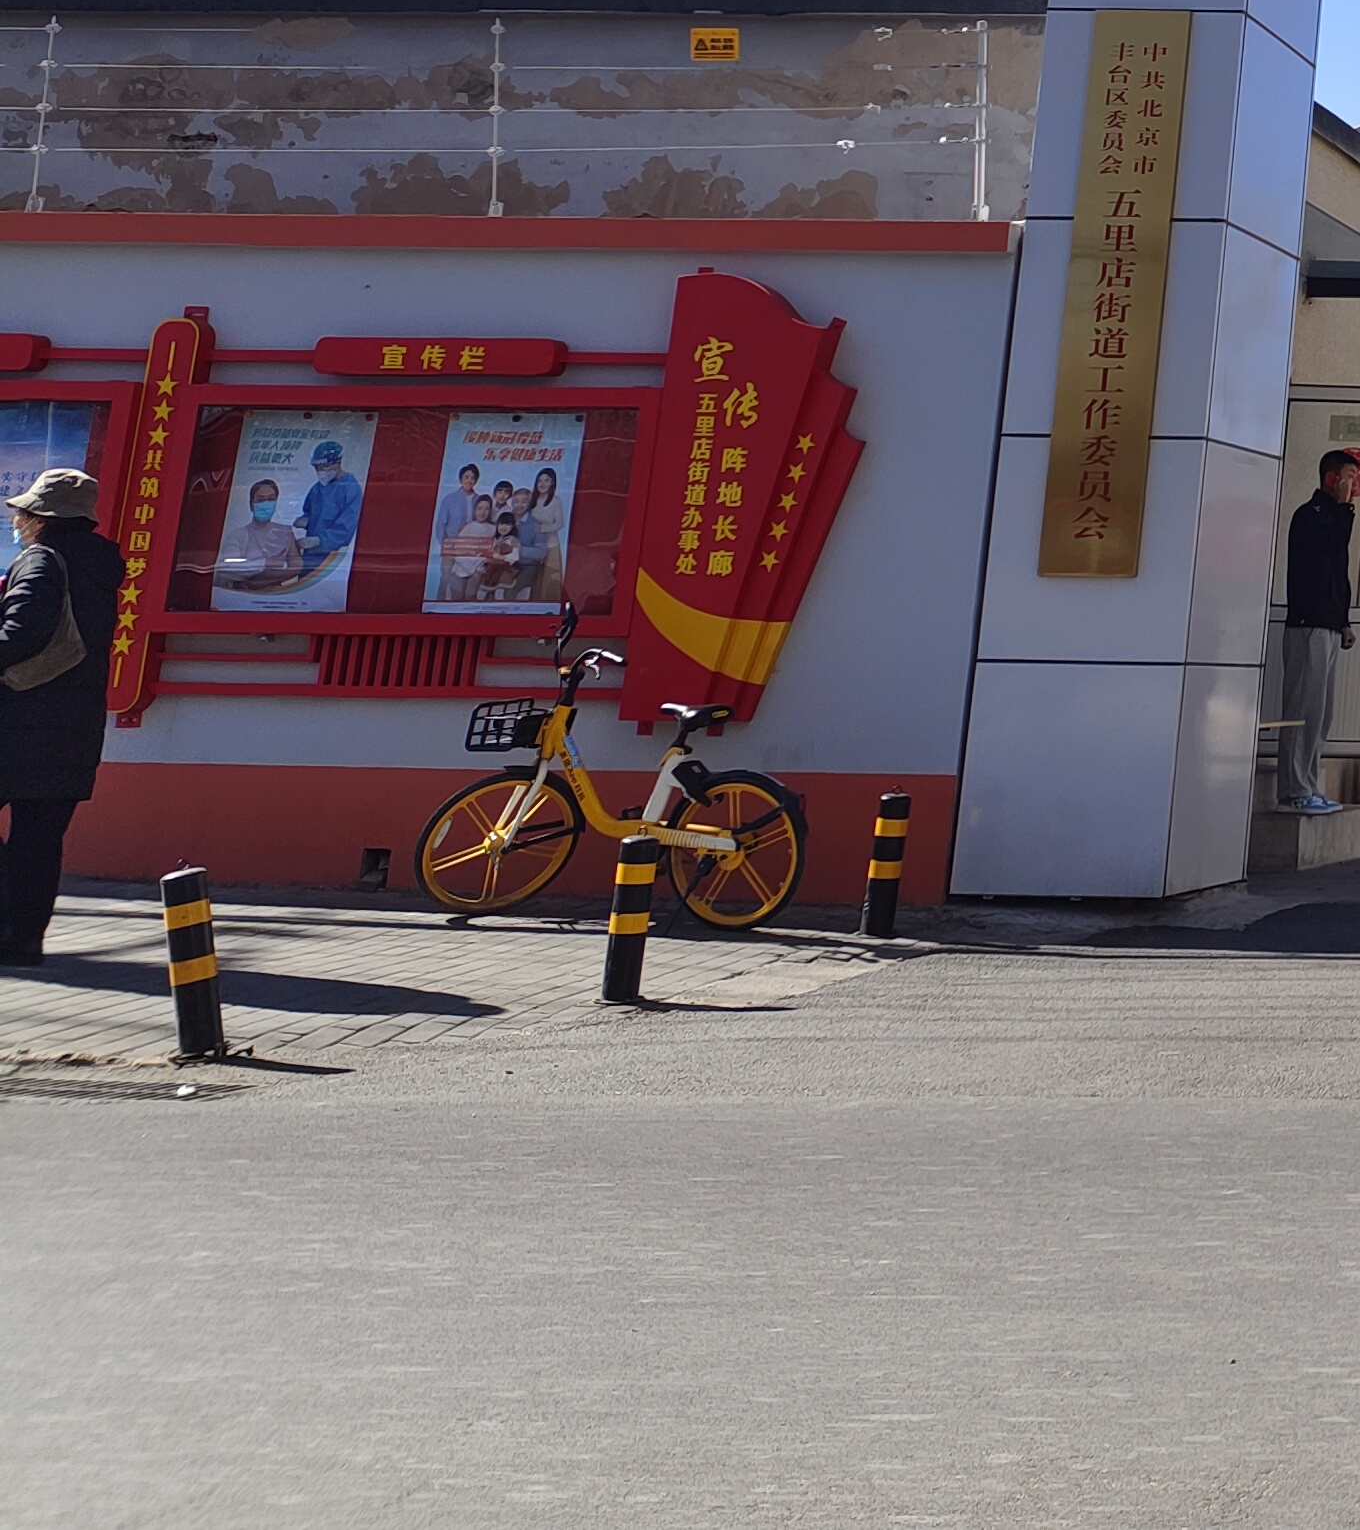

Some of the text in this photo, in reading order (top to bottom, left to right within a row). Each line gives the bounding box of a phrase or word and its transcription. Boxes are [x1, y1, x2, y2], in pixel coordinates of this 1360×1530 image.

[1098, 41, 1136, 176] 丰台区委员会
[1133, 41, 1168, 176] 中共北京市
[379, 343, 486, 371] 宣传栏
[693, 336, 761, 430] 宣传
[1072, 188, 1143, 541] 五里店街道工作委员会
[125, 449, 165, 580] 共筑中国梦
[675, 392, 719, 575] 五里店街道办事处
[706, 446, 748, 578] 阵地长廊
